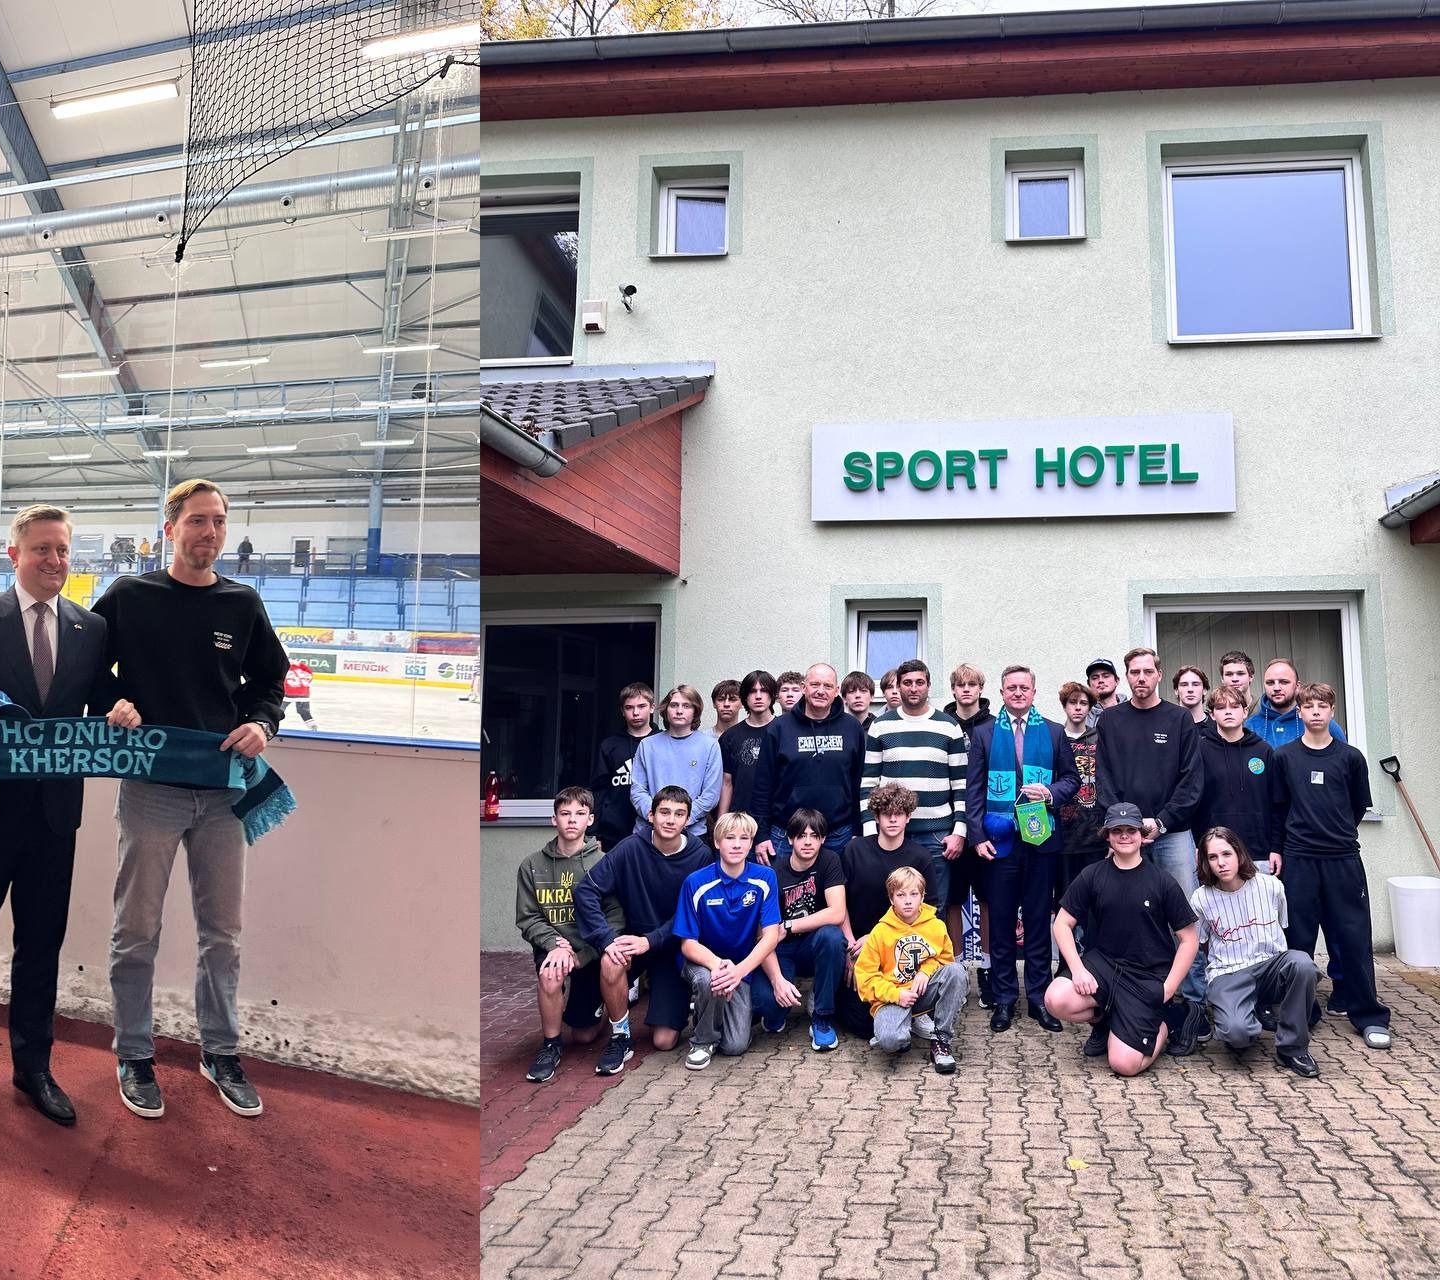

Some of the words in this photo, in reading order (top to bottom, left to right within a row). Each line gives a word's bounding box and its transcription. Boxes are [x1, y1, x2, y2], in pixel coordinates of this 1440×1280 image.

[843, 448, 1008, 491] SPORT
[1035, 443, 1199, 488] HOTEL
[279, 631, 316, 644] CORNY
[54, 721, 168, 750] DNIPRO
[8, 747, 156, 776] KHERSON
[612, 772, 632, 787] adi
[536, 888, 574, 904] UKRA
[548, 907, 576, 924] OCK
